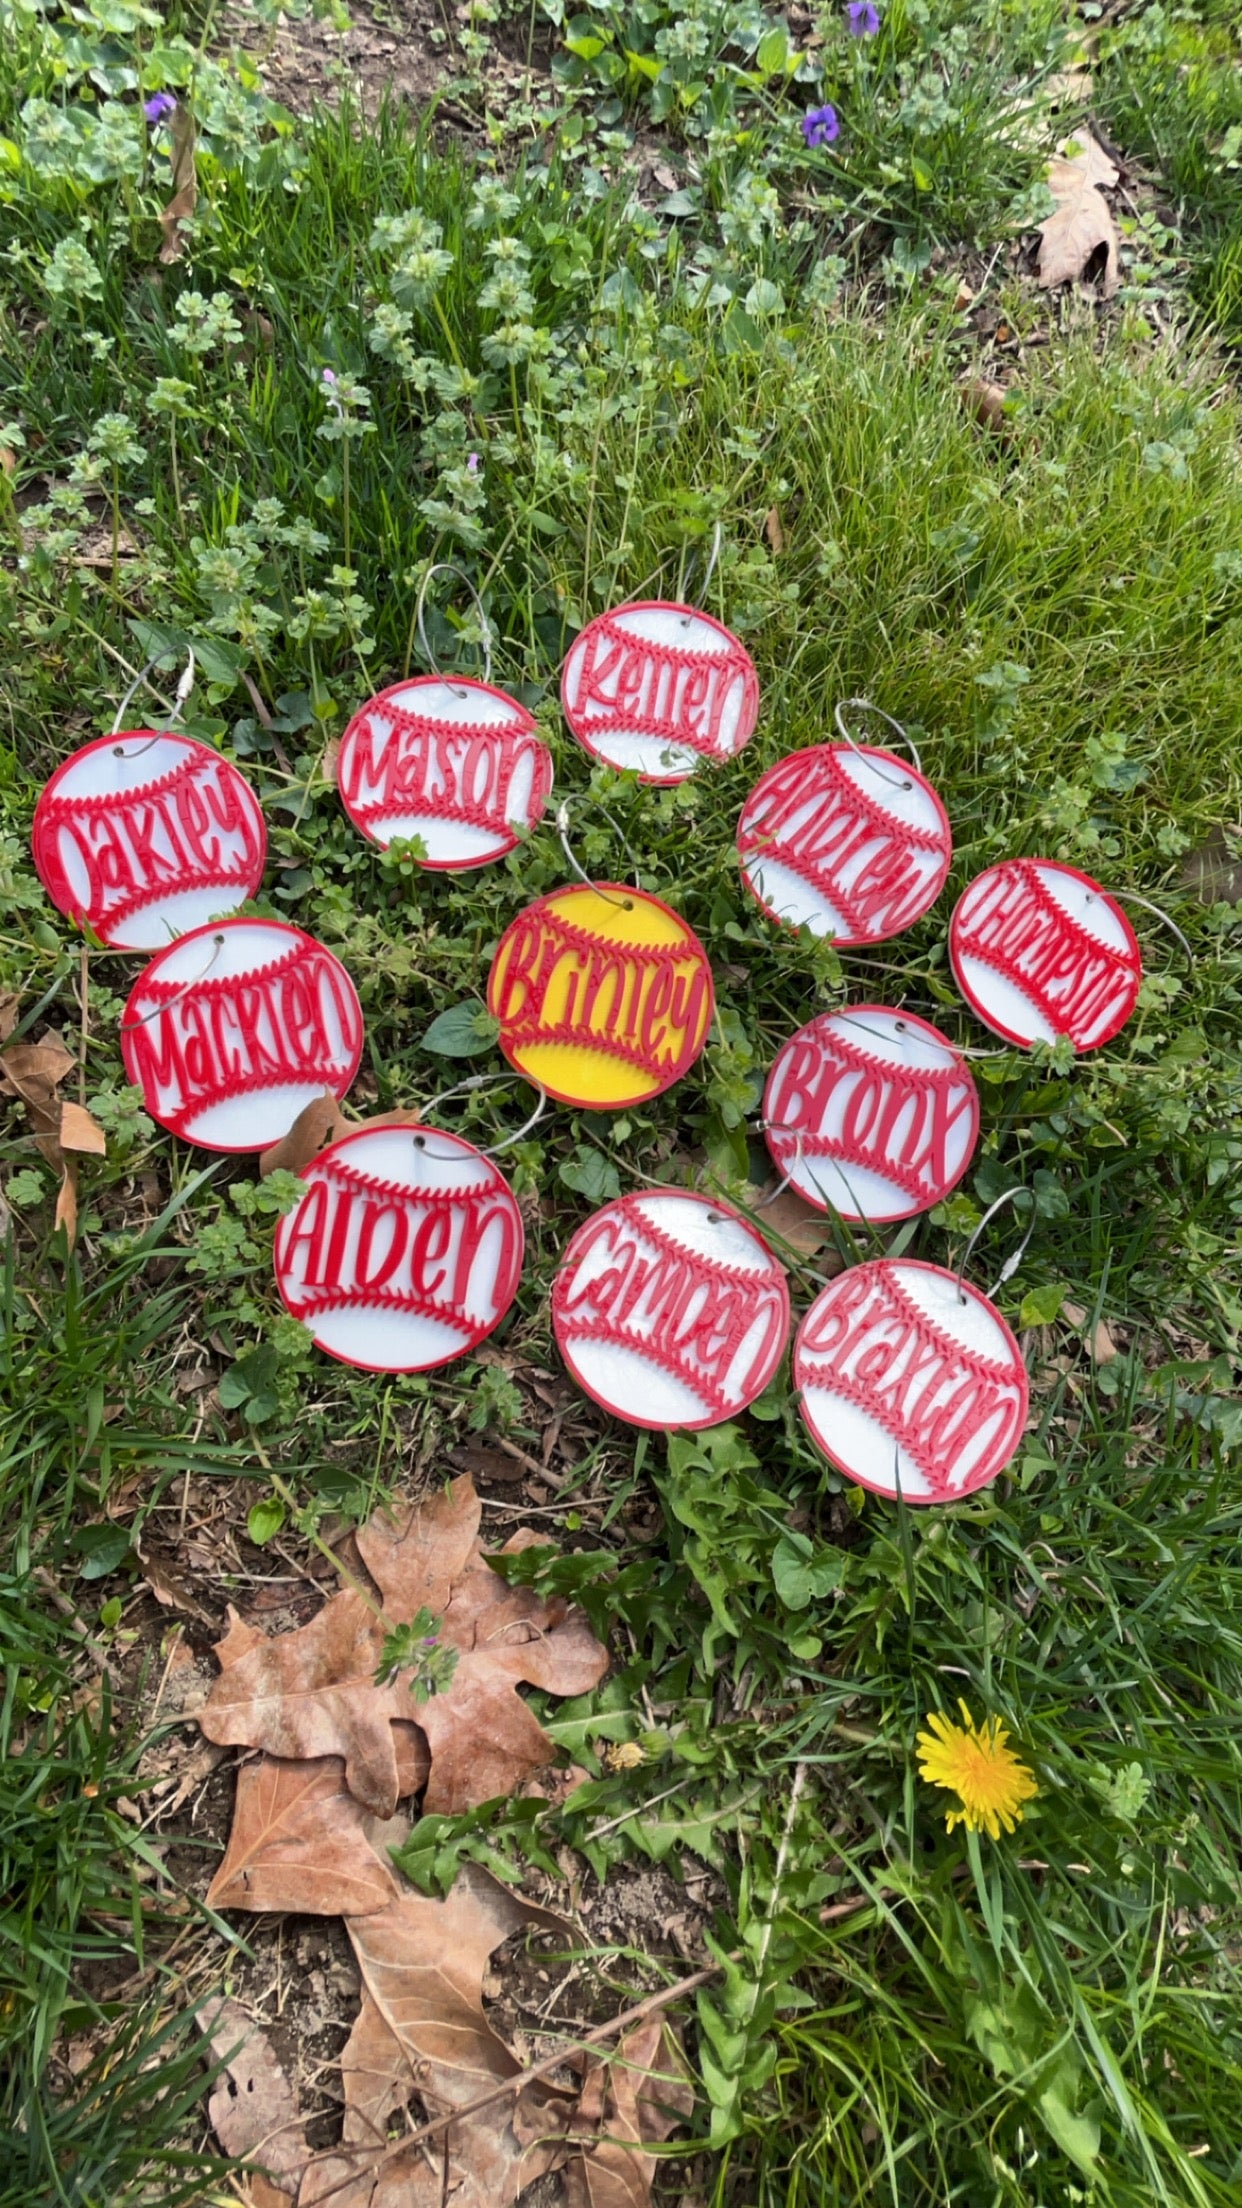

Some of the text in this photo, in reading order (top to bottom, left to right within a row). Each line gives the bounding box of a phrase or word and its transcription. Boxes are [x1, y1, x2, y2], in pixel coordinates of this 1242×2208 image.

[346, 717, 548, 823] Mason
[571, 628, 757, 753] Kellen
[40, 763, 260, 924] Oakley
[743, 755, 944, 934] Andrew
[123, 953, 357, 1114] Macklen
[499, 920, 711, 1075] Brinley
[957, 864, 1138, 1047] Thompson
[771, 1040, 976, 1188] Bronx
[558, 1219, 780, 1397] Camden
[802, 1271, 1017, 1490] Braxton
